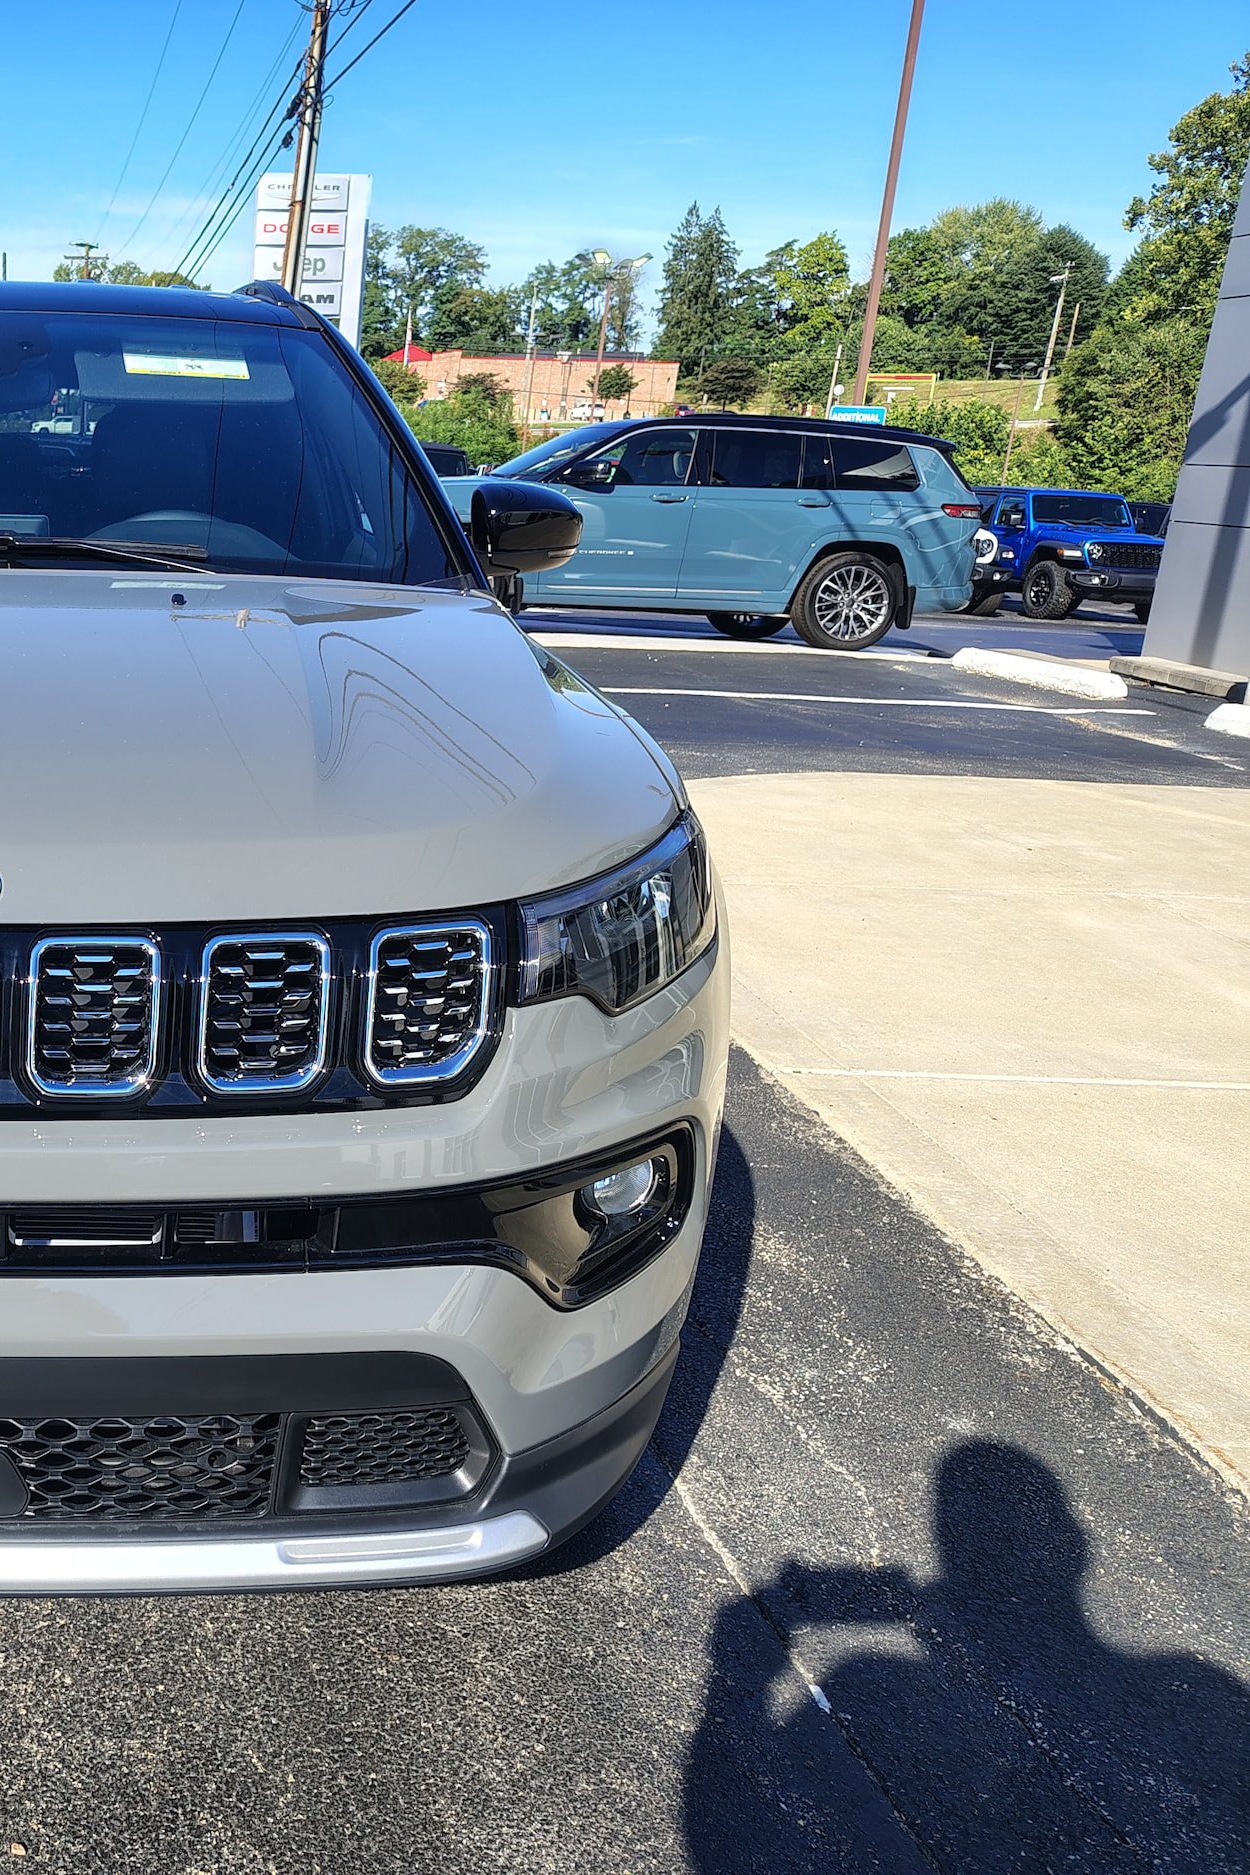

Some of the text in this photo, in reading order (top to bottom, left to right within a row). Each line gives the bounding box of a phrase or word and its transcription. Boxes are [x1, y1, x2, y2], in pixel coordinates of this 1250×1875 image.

[268, 183, 341, 191] CHRLER
[263, 224, 340, 234] DOGE
[299, 294, 335, 304] AM
[832, 412, 881, 424] ADDITIONAL
